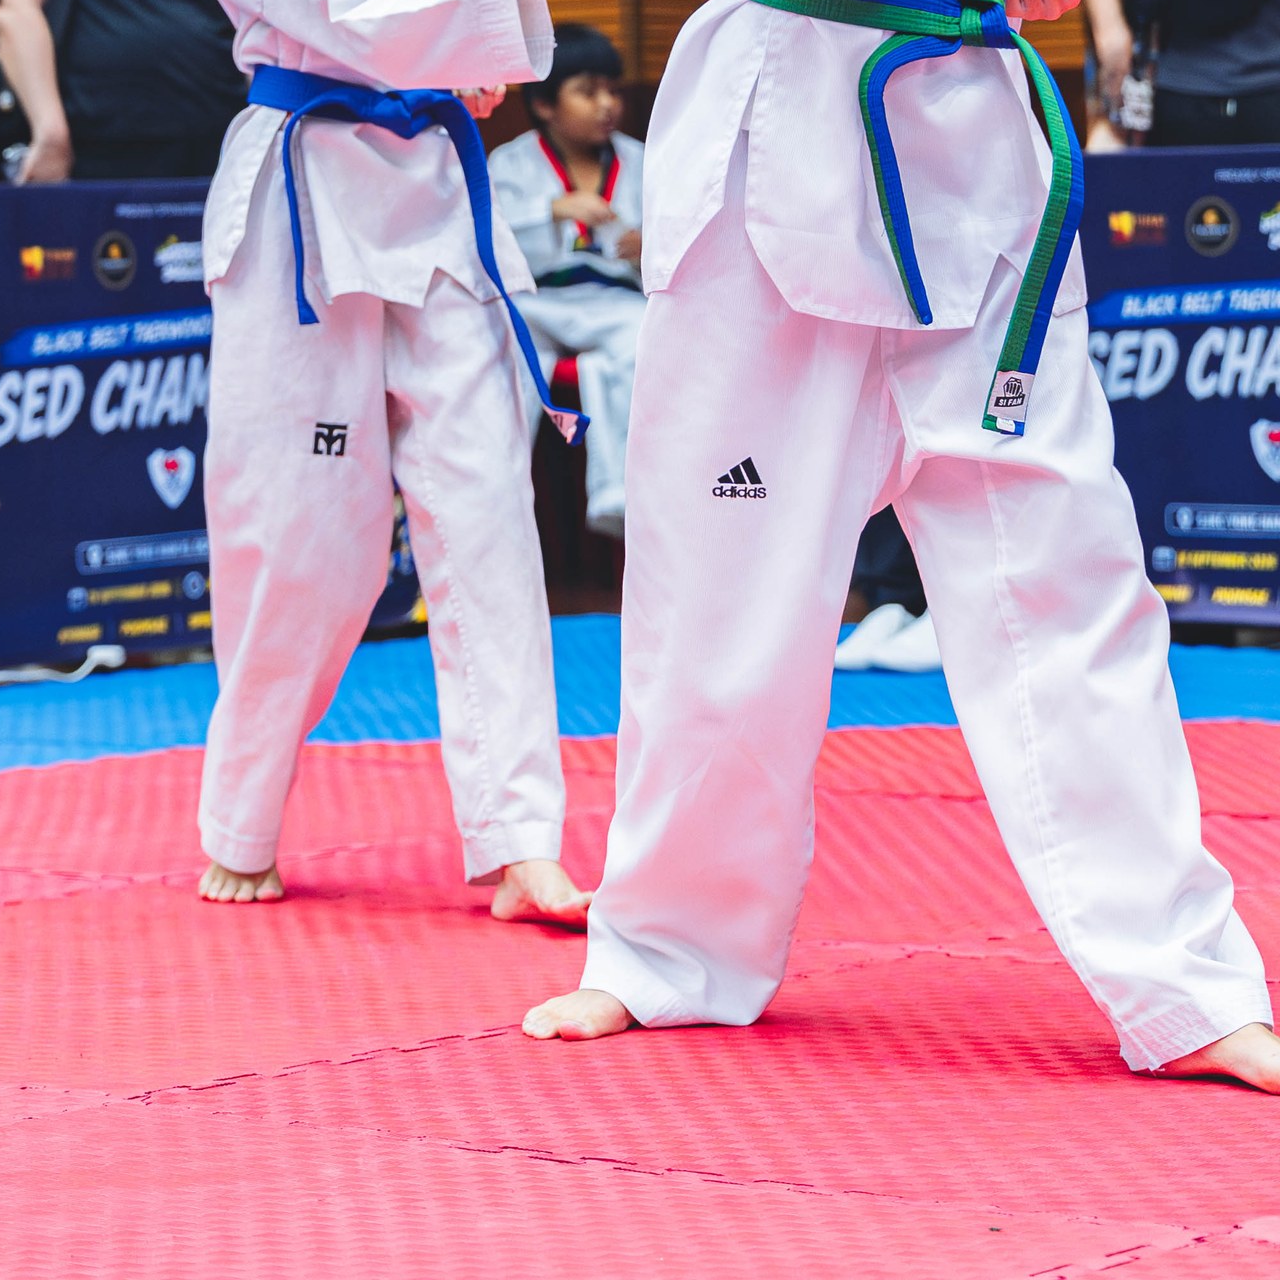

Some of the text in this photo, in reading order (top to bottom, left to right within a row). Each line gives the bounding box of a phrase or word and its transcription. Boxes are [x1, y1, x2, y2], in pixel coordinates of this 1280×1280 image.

[1180, 290, 1225, 315] BELT
[1088, 328, 1179, 402] SED
[712, 485, 767, 499] adidas
